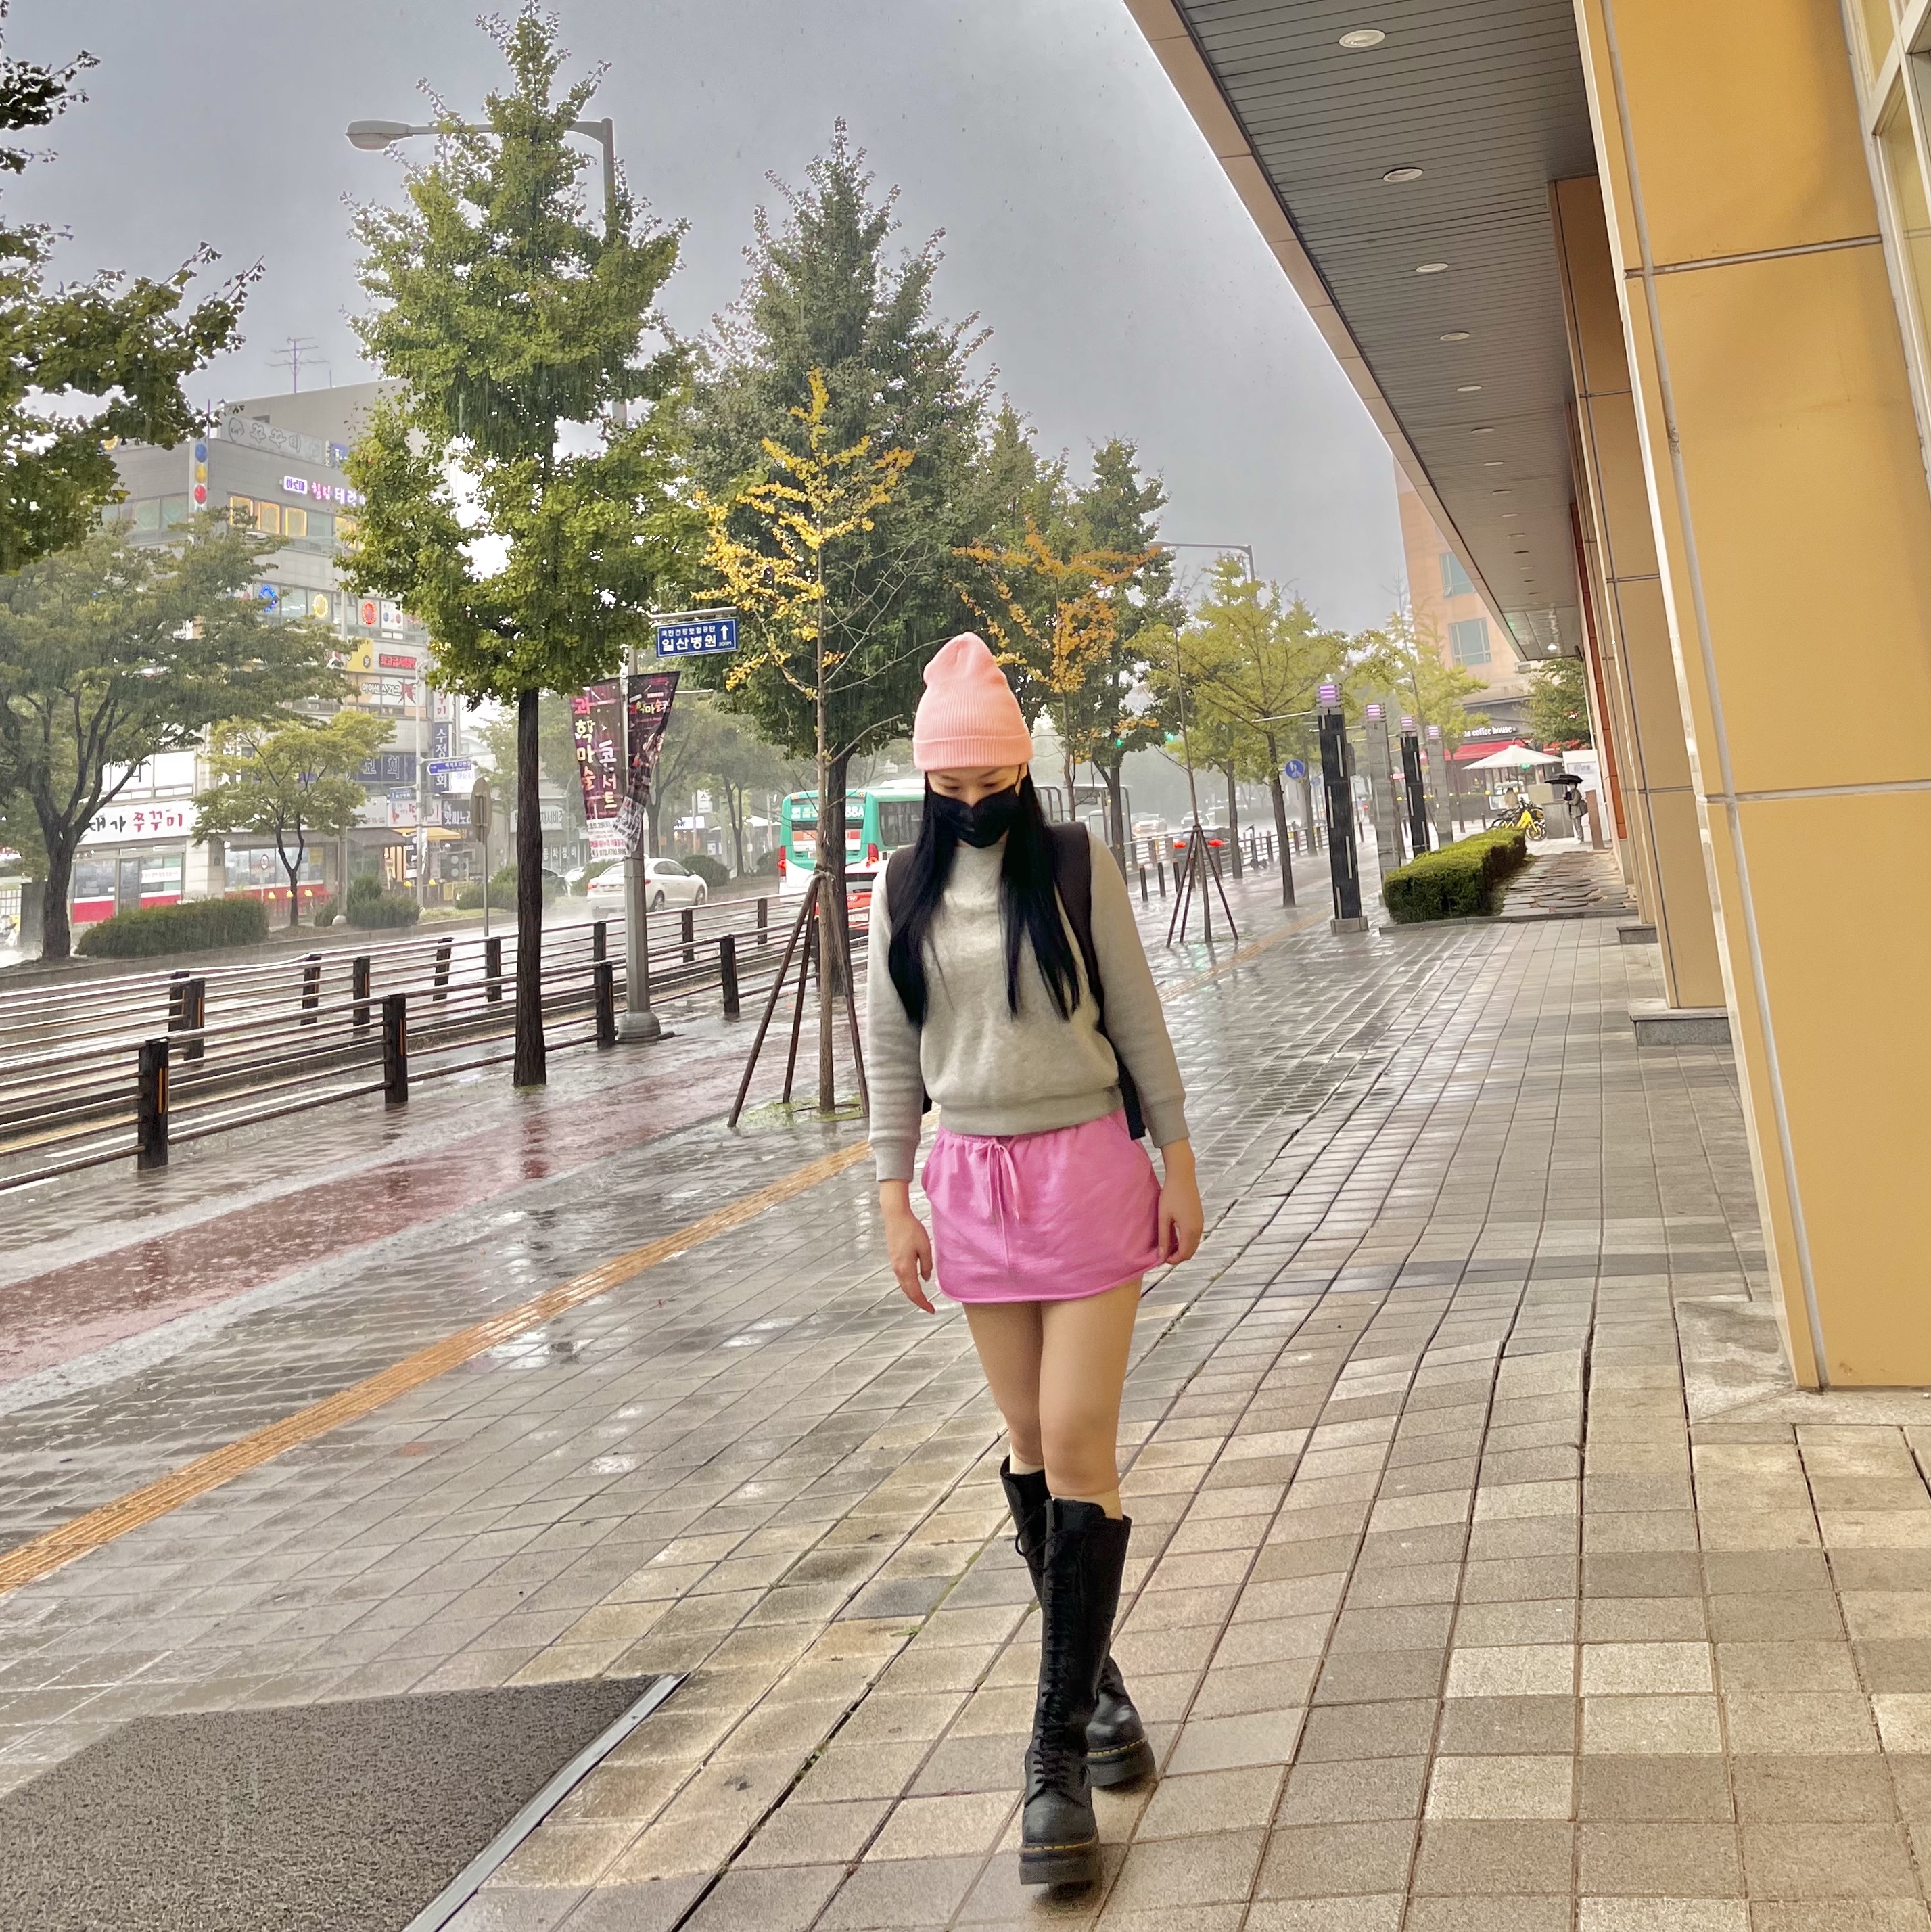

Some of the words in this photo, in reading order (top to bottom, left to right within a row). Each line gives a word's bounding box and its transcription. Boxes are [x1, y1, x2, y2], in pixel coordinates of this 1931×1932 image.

[286, 478, 306, 492] 아로마
[311, 482, 330, 500] 힐링
[661, 634, 716, 652] 일산병원
[1472, 727, 1492, 737] coffee
[1492, 725, 1512, 735] house
[574, 697, 596, 791] 과학마술
[435, 729, 448, 788] 수정회
[599, 739, 618, 808] 콘서트
[133, 811, 183, 833] 쭈꾸미
